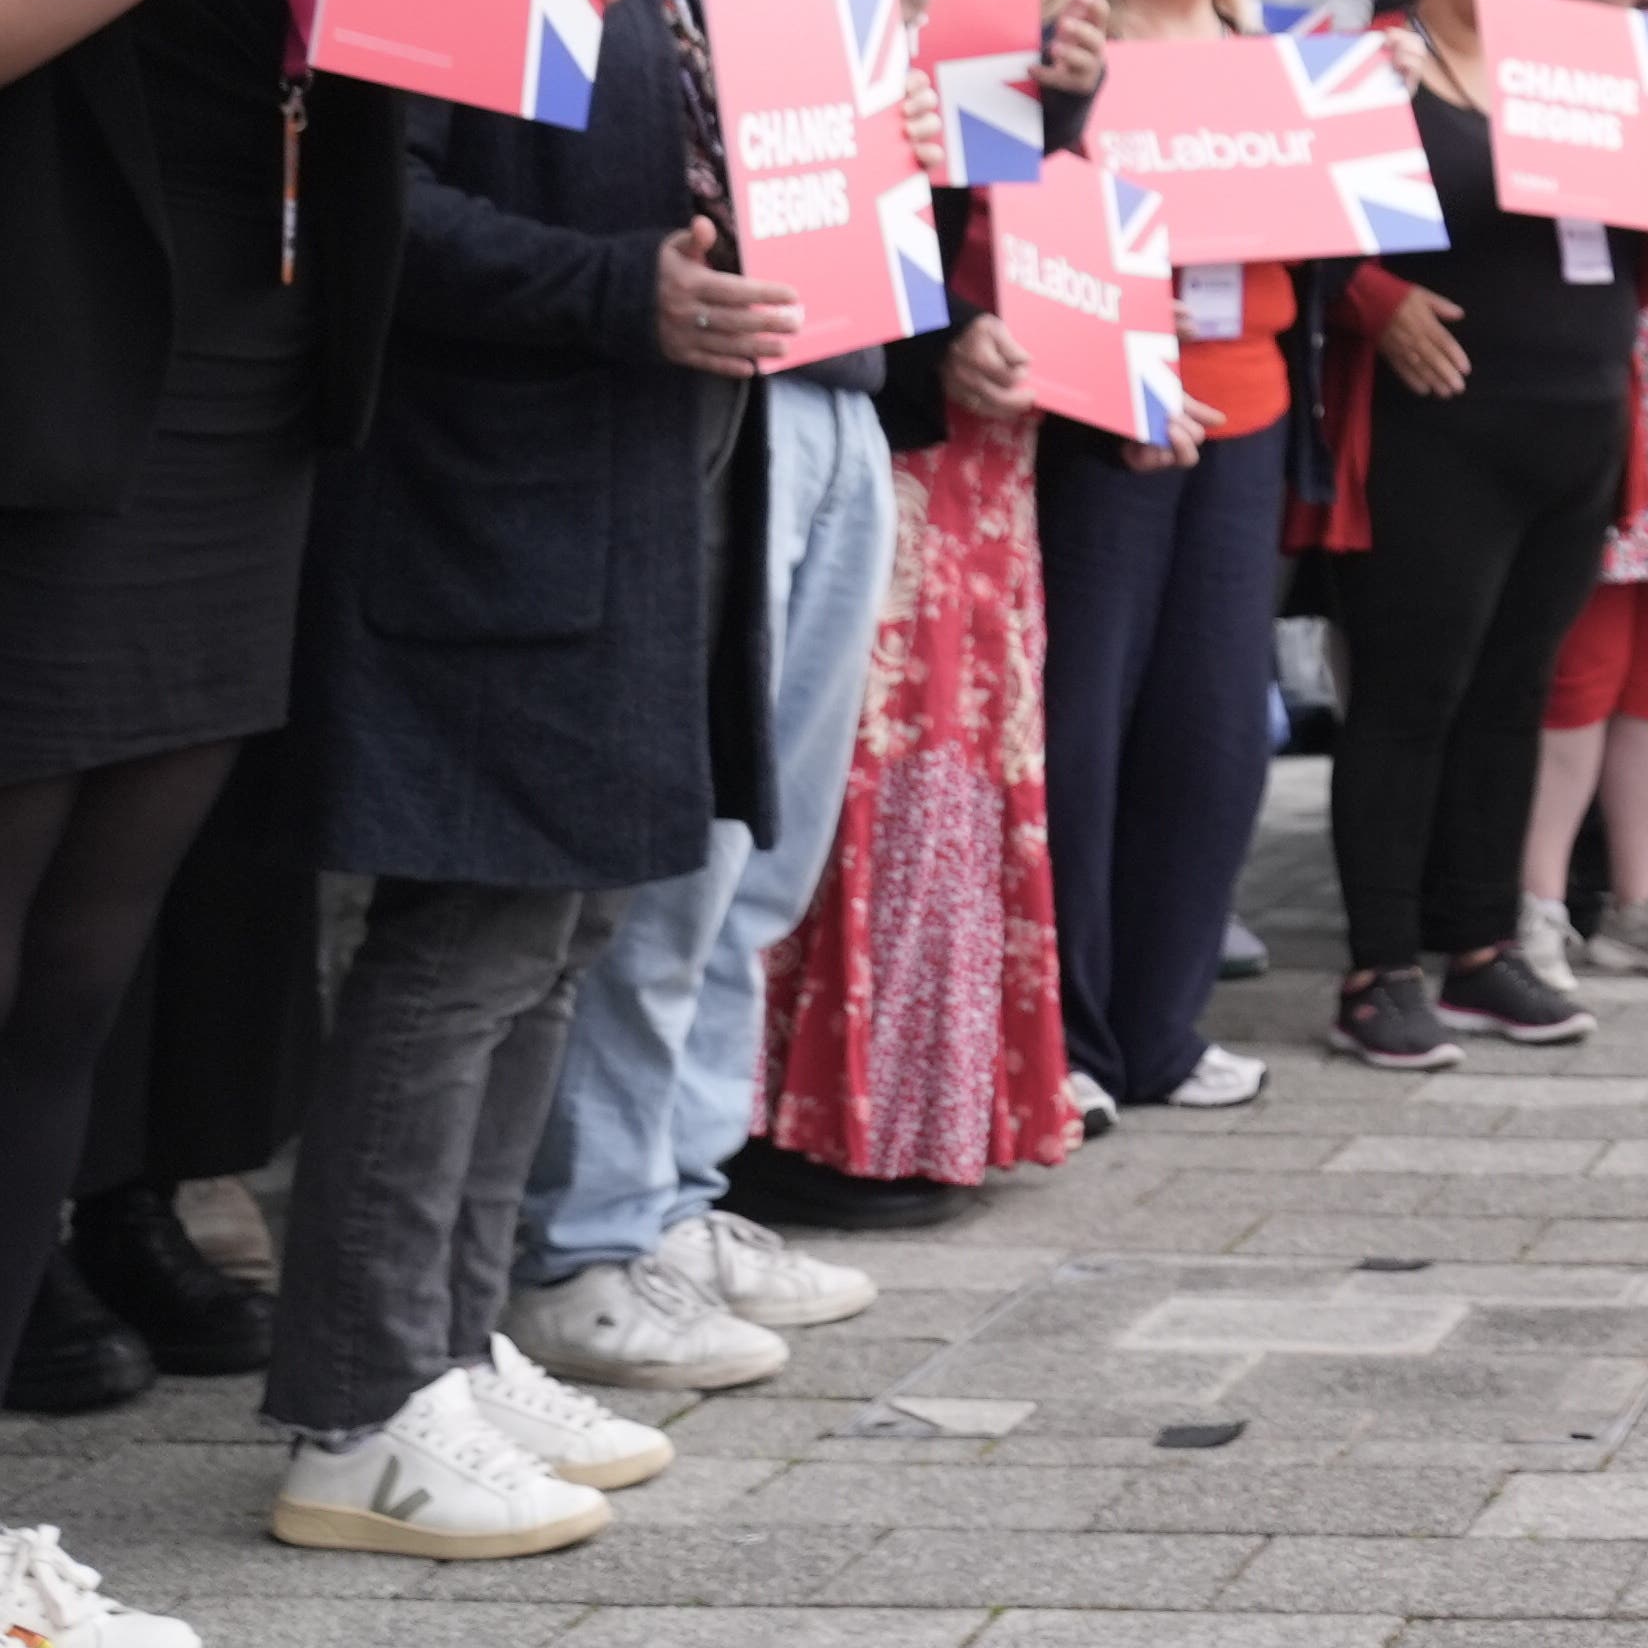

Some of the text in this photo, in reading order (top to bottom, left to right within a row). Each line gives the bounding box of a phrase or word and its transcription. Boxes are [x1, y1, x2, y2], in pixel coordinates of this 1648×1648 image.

[1497, 57, 1640, 118] CHANGE
[738, 101, 858, 171] CHANGE
[1142, 127, 1316, 173] Labour
[1503, 97, 1624, 152] BEGINS
[747, 167, 851, 240] BEGINS
[1022, 242, 1122, 325] Labour
